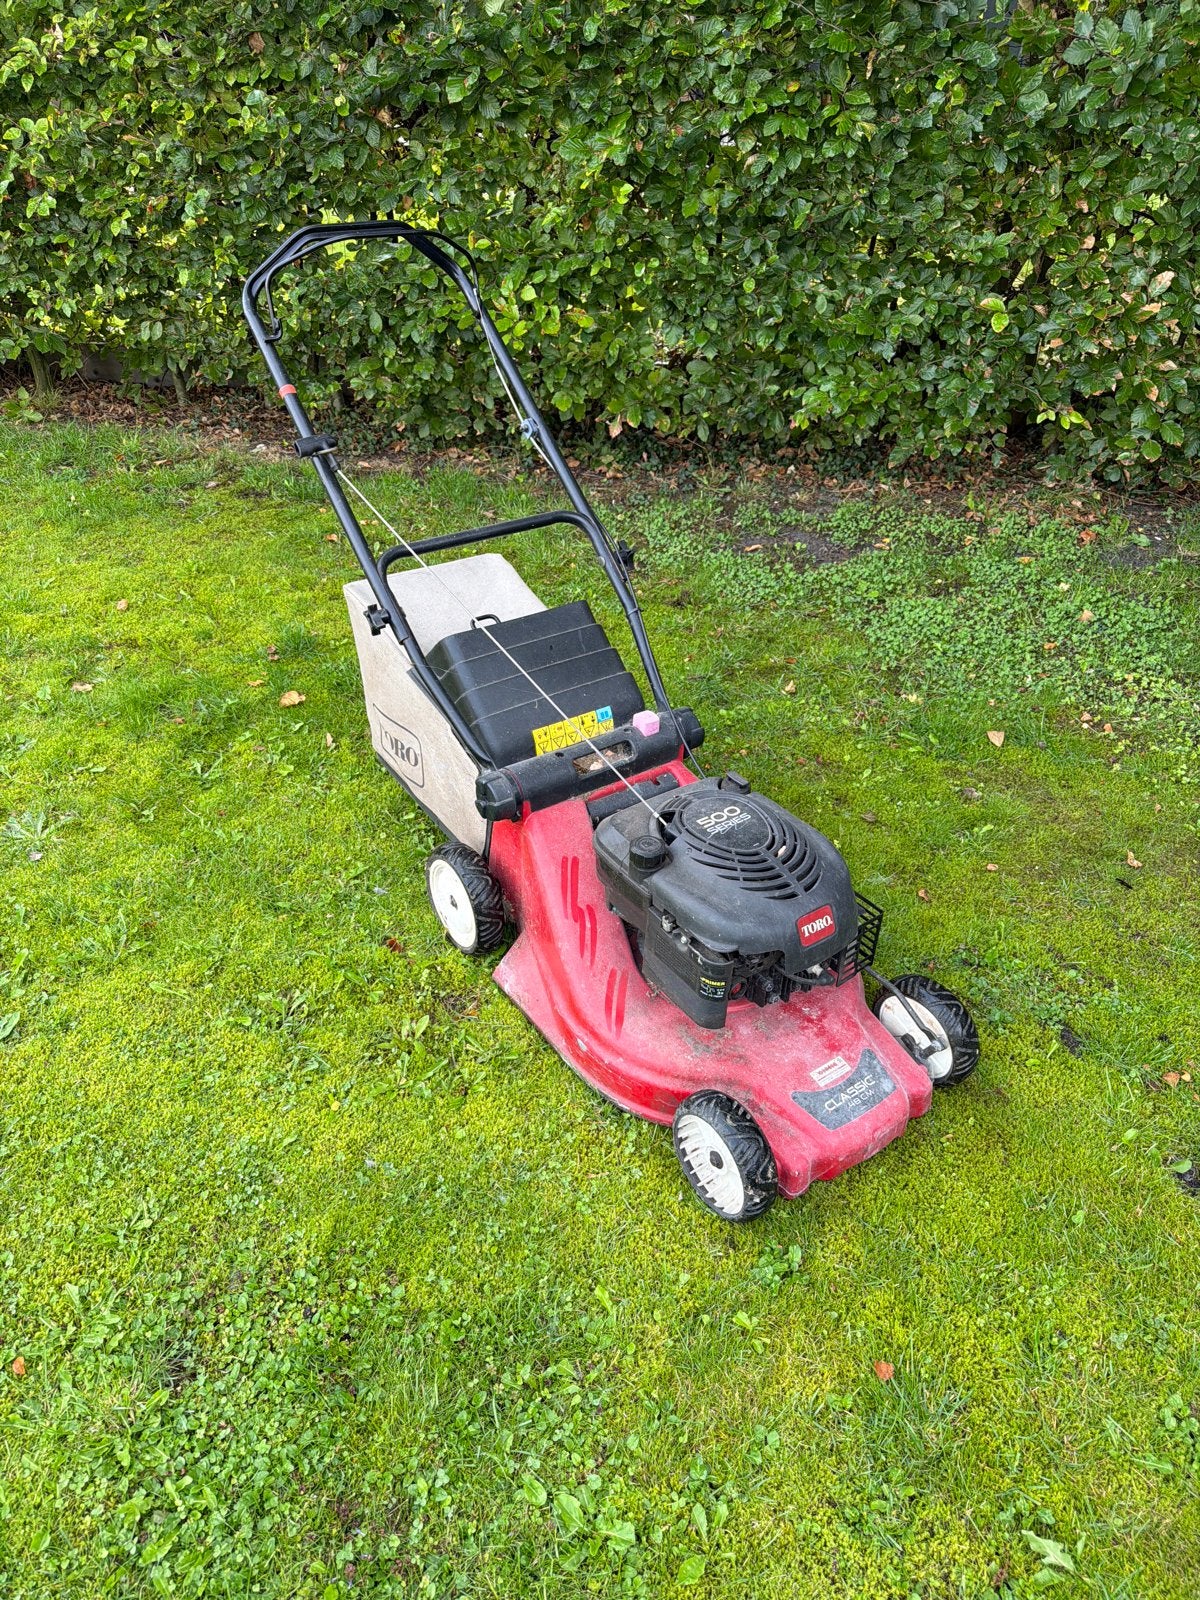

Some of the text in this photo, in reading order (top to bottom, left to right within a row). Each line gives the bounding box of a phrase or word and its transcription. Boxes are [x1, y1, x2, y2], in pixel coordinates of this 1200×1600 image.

[696, 806, 741, 828] 500
[707, 812, 751, 835] SERIES
[824, 1074, 876, 1111] CLASSIC
[848, 1089, 875, 1107] 48 CM
